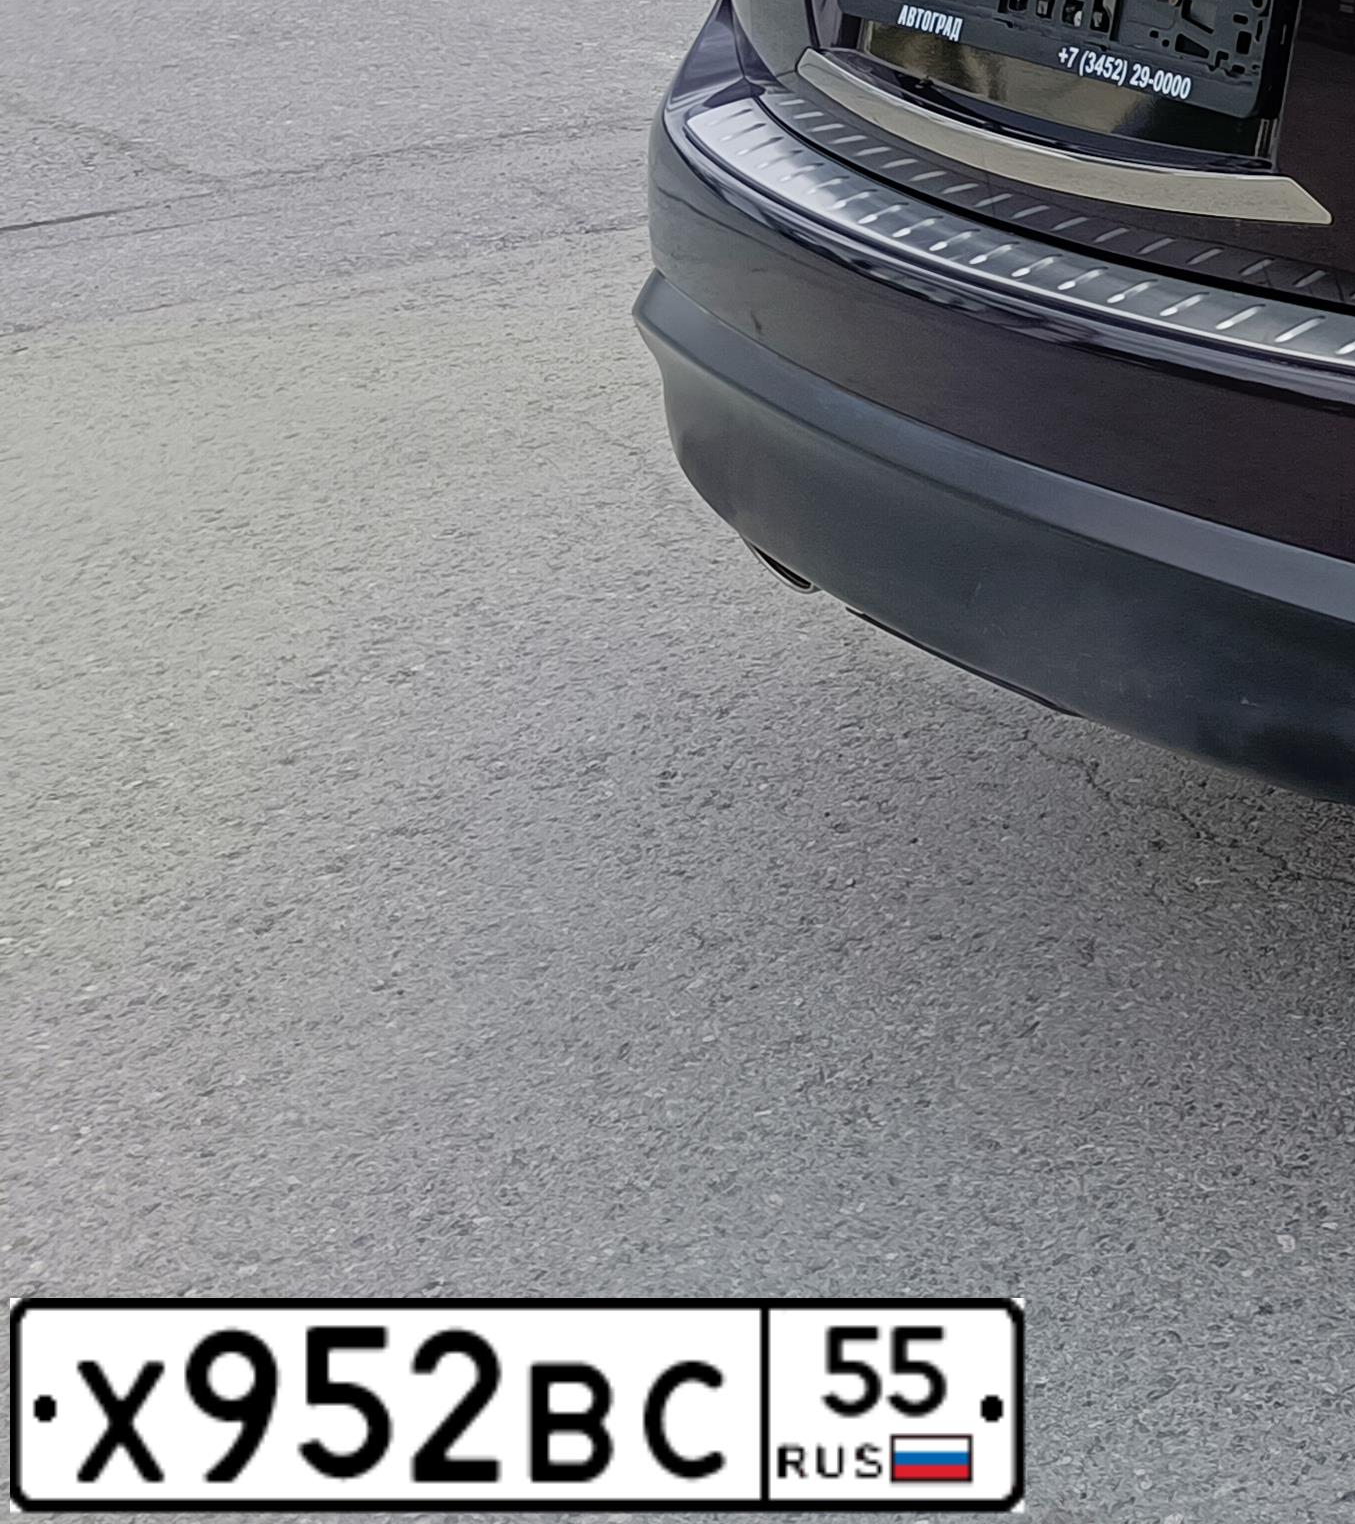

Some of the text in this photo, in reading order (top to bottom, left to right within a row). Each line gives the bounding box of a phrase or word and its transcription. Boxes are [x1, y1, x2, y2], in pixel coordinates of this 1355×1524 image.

[897, 5, 964, 42] АВТОГРАД
[1058, 46, 1192, 100] +7 (3452) 29-0000
